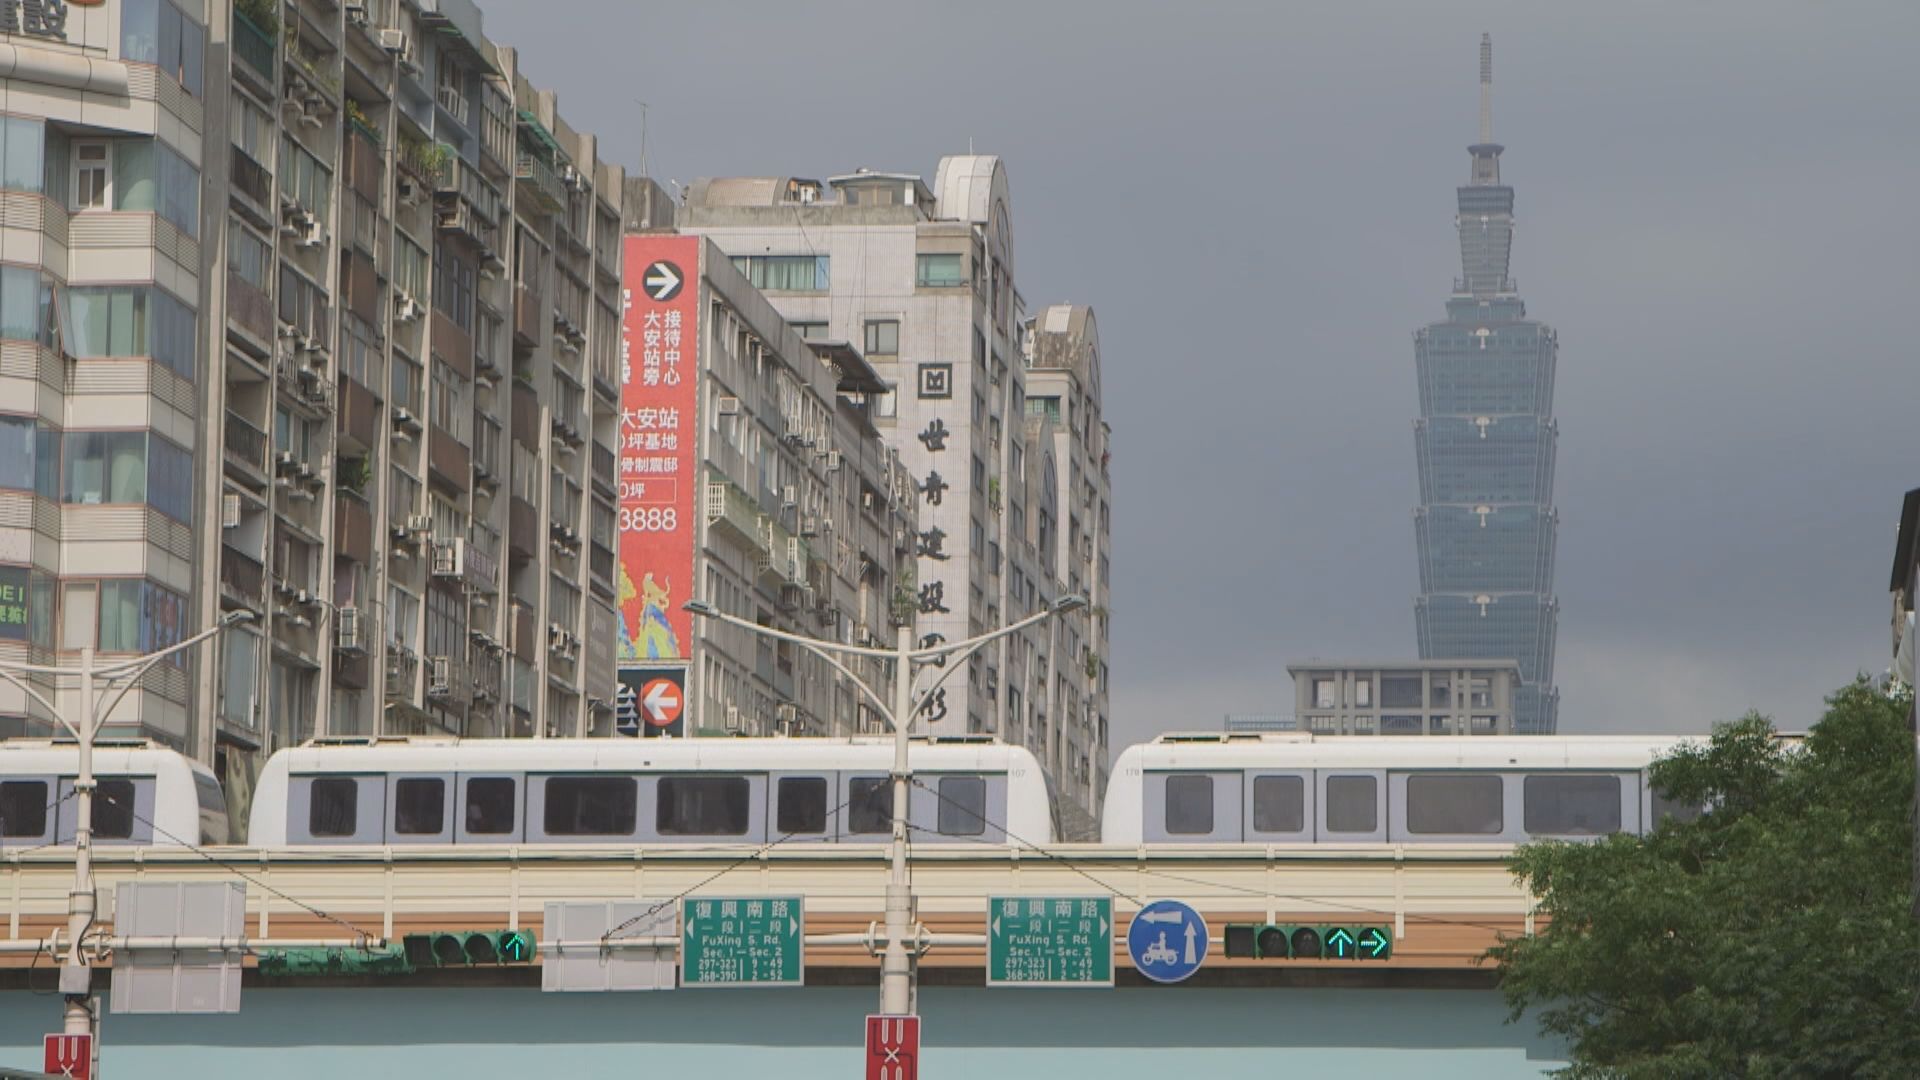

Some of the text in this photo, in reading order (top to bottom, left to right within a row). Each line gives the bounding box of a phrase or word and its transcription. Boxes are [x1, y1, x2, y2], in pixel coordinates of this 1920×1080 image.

[642, 309, 661, 387] 大安站旁
[663, 309, 682, 387] 接待中心
[621, 406, 679, 430] 大安站
[619, 506, 677, 532] 3888
[695, 901, 788, 919] 復興南路
[1002, 900, 1098, 918] 復興南路
[702, 935, 741, 948] FuXing
[763, 935, 781, 946] Rd.
[1008, 934, 1050, 948] FuXing
[1072, 934, 1090, 945] Rd.
[702, 947, 726, 958] Sec.
[749, 947, 772, 957] Sec.
[774, 947, 782, 957] 2
[1009, 946, 1033, 957] Sec.
[1057, 946, 1081, 957] Sec.
[1084, 946, 1092, 957] 2
